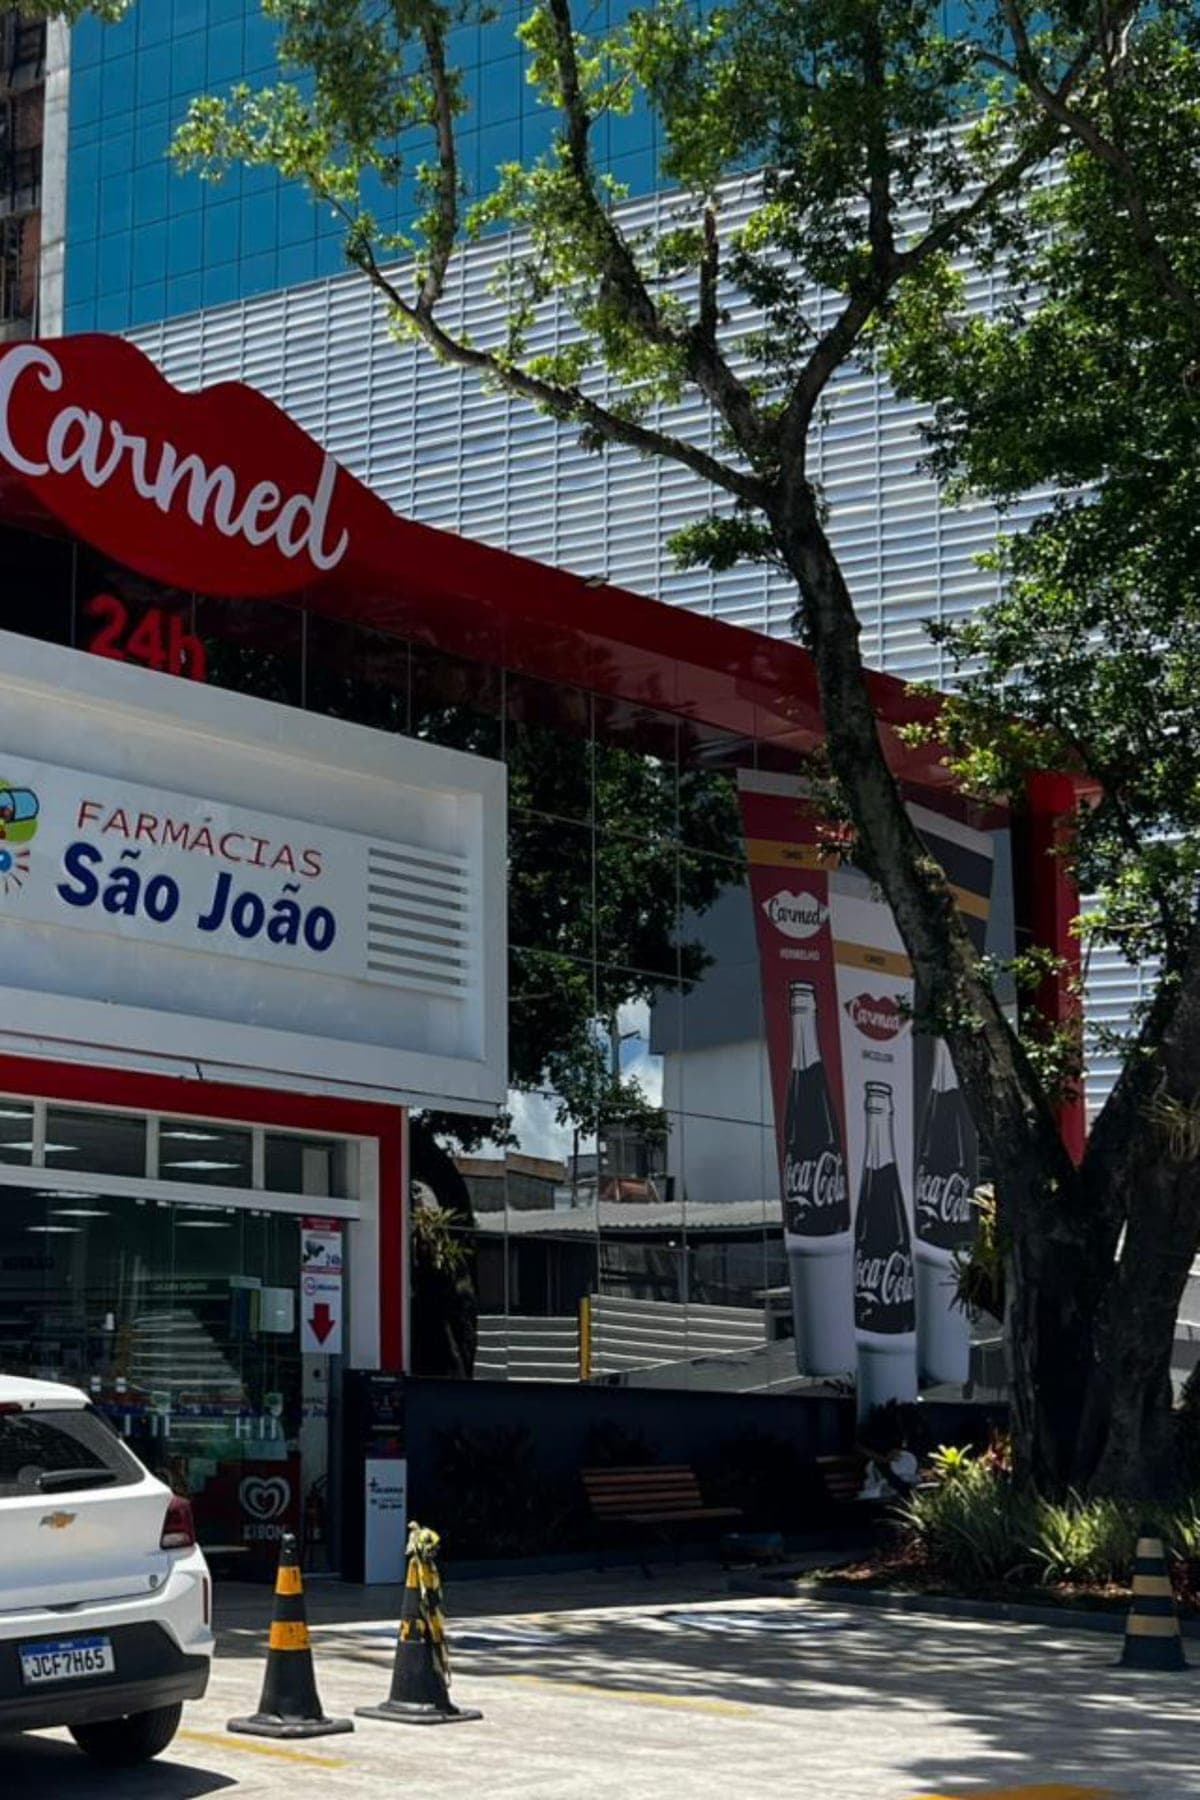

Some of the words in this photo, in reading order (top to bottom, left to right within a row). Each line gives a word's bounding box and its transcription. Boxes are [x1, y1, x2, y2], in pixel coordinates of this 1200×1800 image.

[86, 594, 207, 682] 24h
[77, 800, 322, 878] FARMÁCIAS
[56, 842, 179, 923] São
[197, 871, 336, 952] João
[768, 898, 824, 925] Carmed
[856, 1250, 913, 1304] oca-Cola
[31, 1649, 105, 1678] JCF7H65
